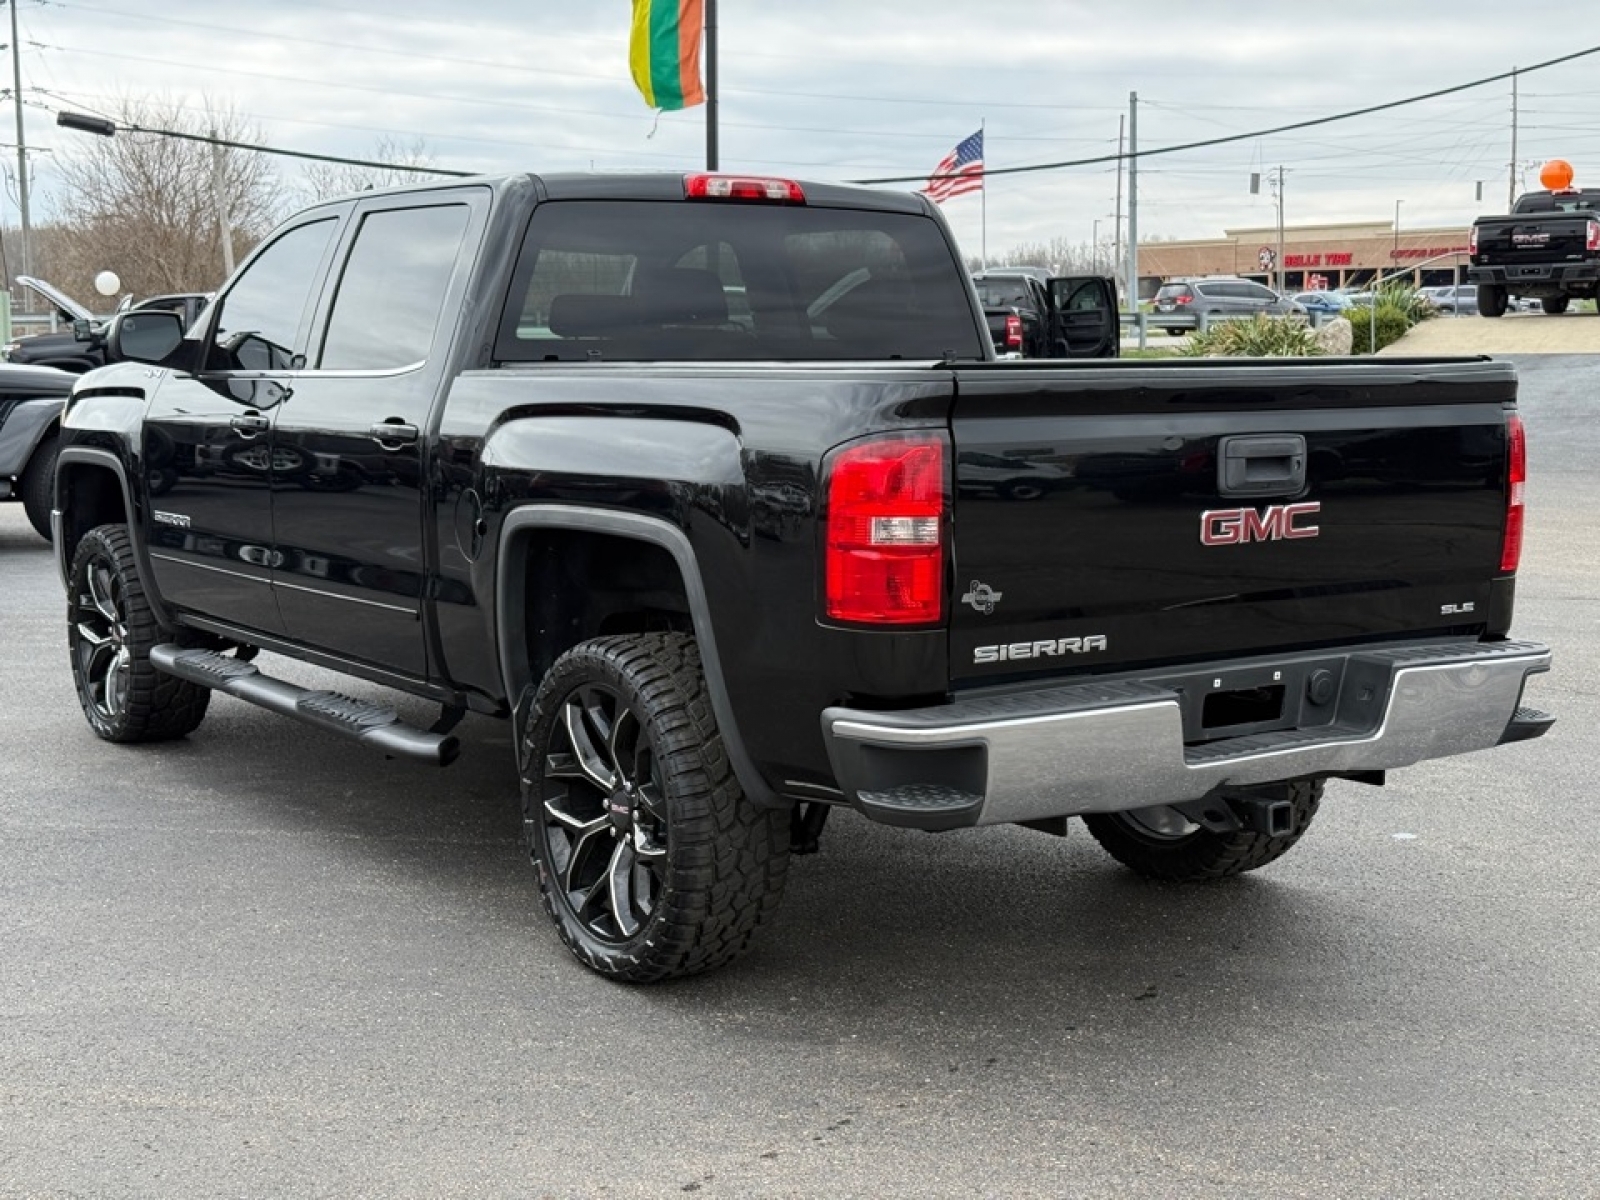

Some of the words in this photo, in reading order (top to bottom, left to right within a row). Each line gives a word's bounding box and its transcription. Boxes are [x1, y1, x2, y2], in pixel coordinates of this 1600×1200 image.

[1201, 501, 1320, 545] GMC
[1441, 602, 1474, 615] SLE
[973, 634, 1107, 664] SIERRA
